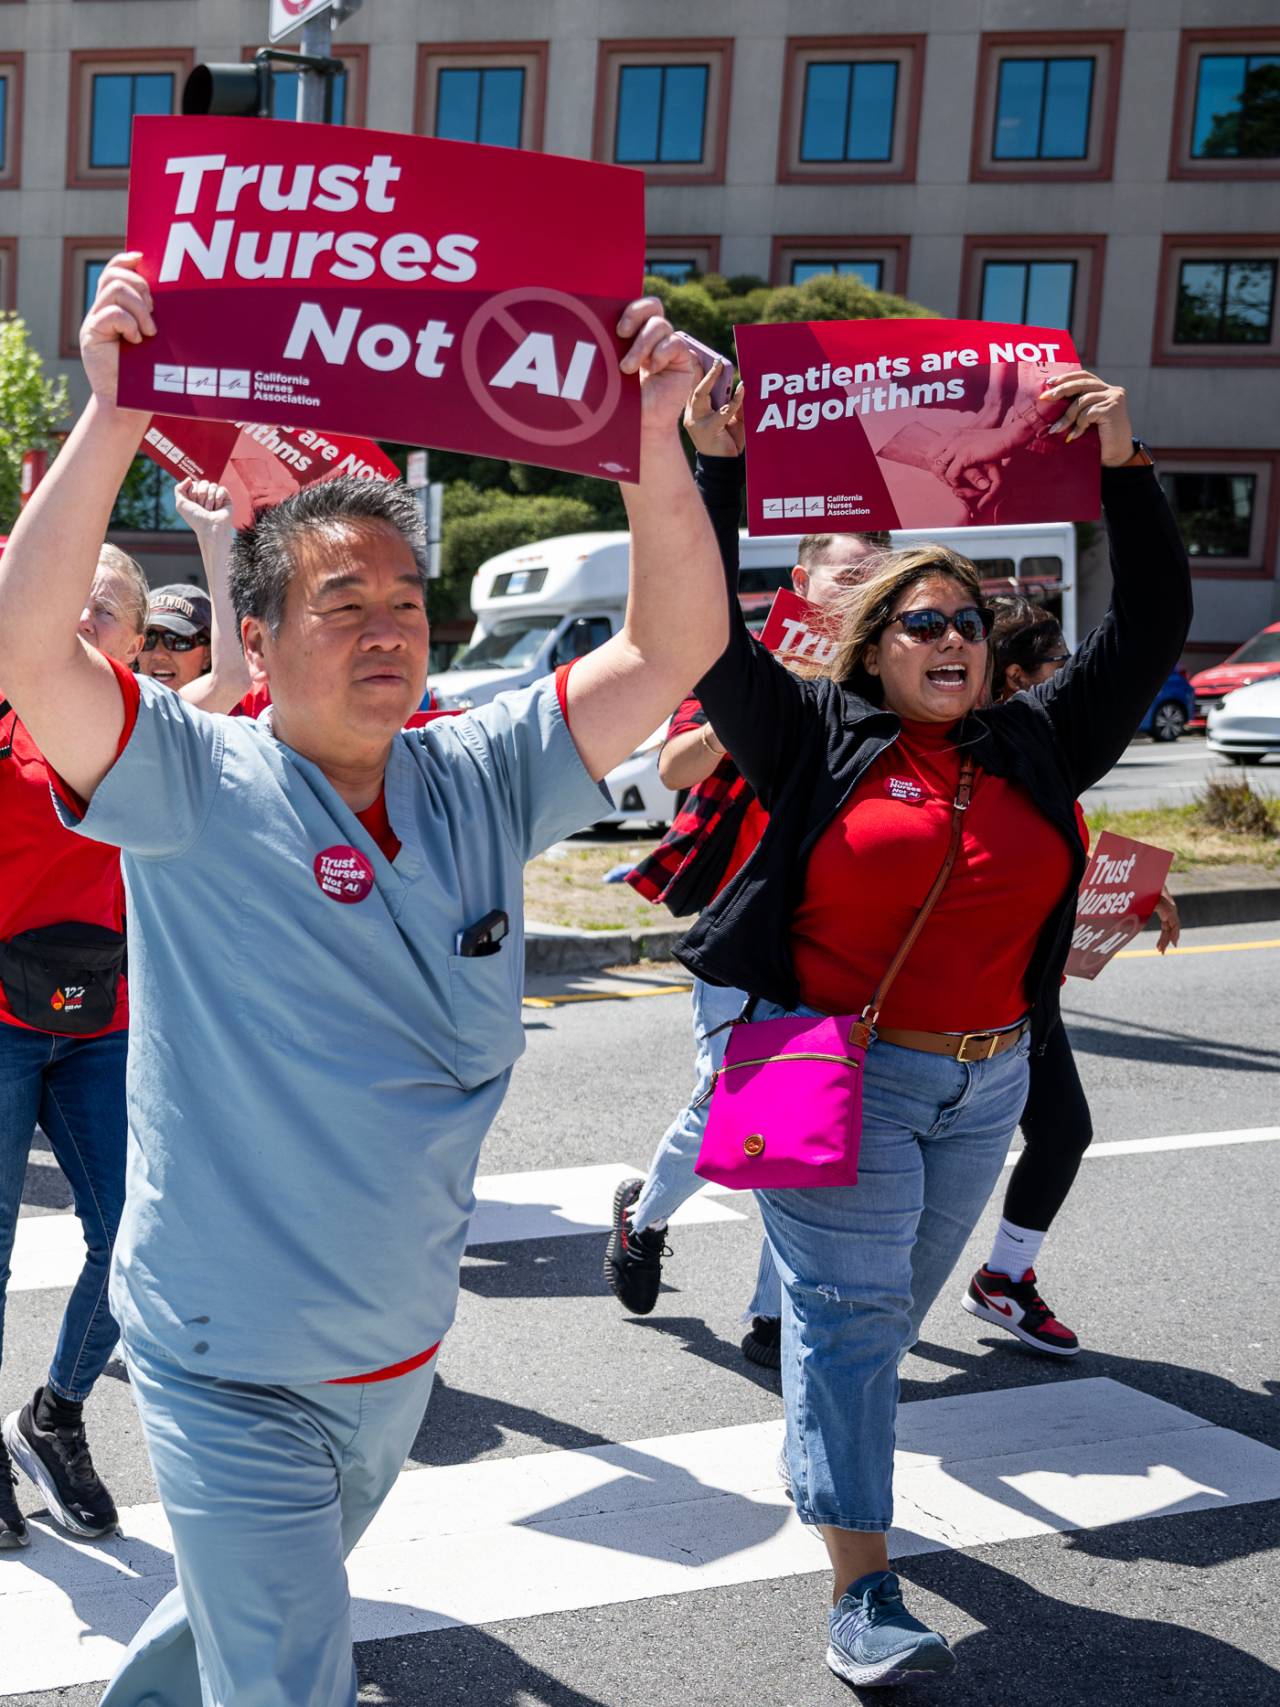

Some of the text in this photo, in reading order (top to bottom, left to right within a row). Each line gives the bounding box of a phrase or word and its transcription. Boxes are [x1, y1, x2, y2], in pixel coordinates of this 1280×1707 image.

[164, 154, 401, 216] Trust
[158, 219, 480, 283] Nurses
[282, 302, 597, 401] Not AI
[254, 371, 310, 386] California
[760, 343, 1060, 400] Patients are NOT
[254, 382, 293, 395] Nurses
[254, 391, 320, 407] Association
[756, 378, 965, 432] Algorithms
[298, 429, 339, 461] are
[827, 494, 863, 503] California
[827, 502, 852, 510] Nurses
[827, 508, 870, 516] Association
[778, 618, 838, 664] Tru
[320, 865, 366, 880] Nurses
[321, 856, 357, 868] Trust
[1088, 853, 1136, 885] Trust
[323, 875, 359, 892] Not AI
[1076, 888, 1135, 916] Nurses
[1071, 923, 1128, 954] Not AI
